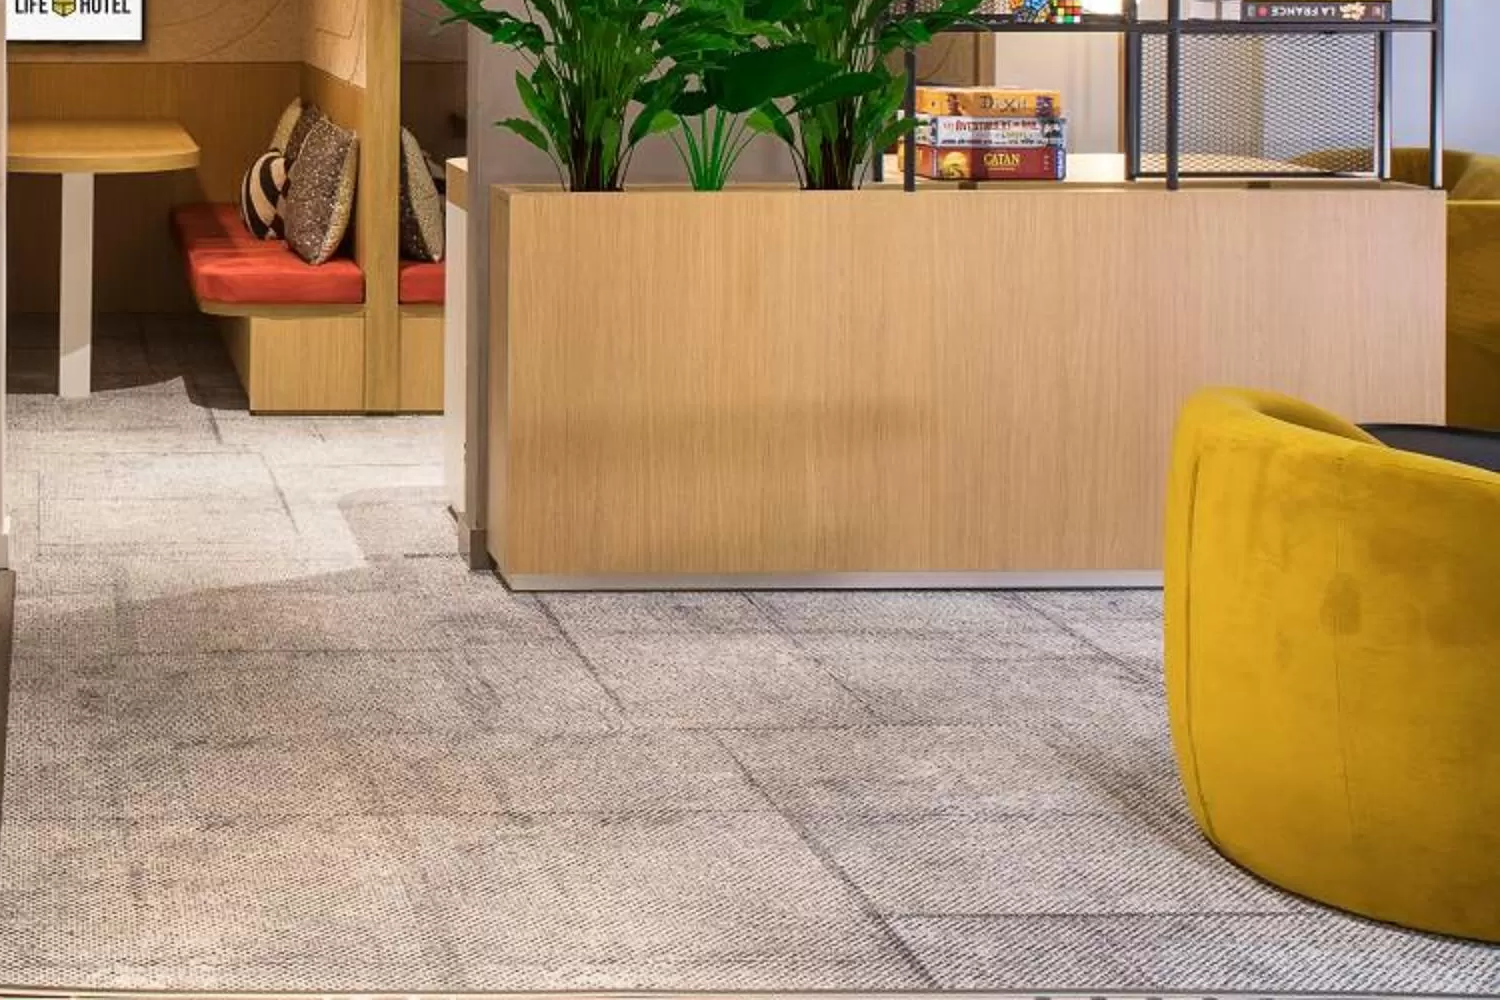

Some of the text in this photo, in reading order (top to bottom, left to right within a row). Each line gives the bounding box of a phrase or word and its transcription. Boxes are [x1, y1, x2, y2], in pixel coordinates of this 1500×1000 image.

[1271, 6, 1336, 17] LA FRANCE
[983, 152, 1020, 166] CATAN
